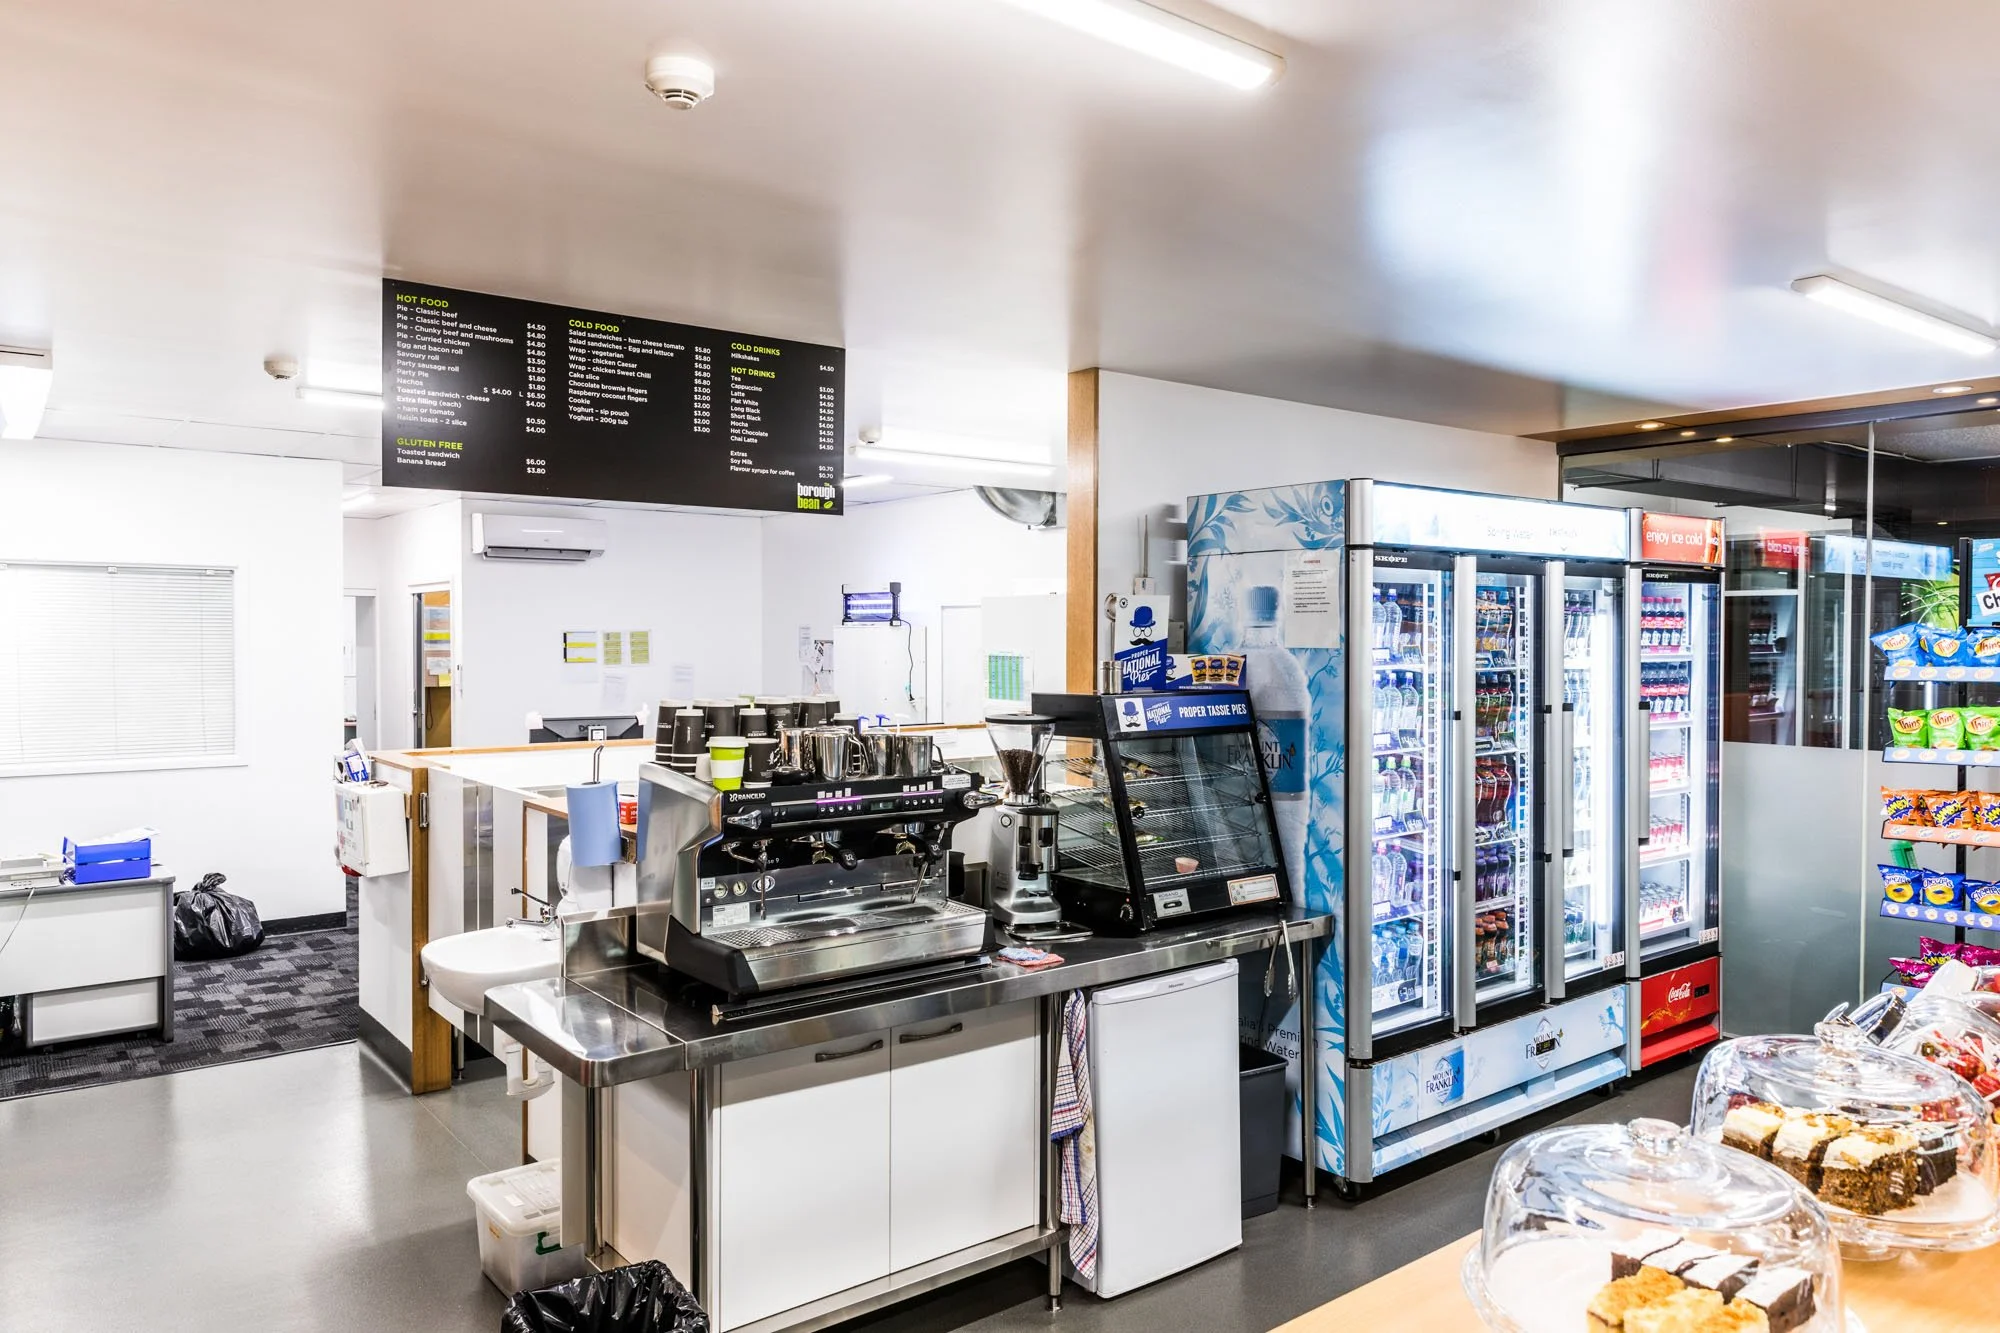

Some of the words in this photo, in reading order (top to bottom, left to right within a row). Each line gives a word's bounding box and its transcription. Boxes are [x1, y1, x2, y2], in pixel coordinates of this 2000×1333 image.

[396, 293, 418, 303] HOT
[420, 297, 449, 308] FOOD
[396, 304, 408, 312] Pie
[415, 307, 440, 316] Classic
[441, 310, 458, 318] beef
[526, 322, 546, 331] $4.50
[396, 313, 408, 321] Pie
[415, 316, 440, 325] Classic
[441, 319, 458, 327] beef
[473, 324, 497, 333] cheese
[526, 331, 546, 340] $4.80
[568, 319, 593, 329] COLD
[594, 323, 620, 333] FOOD
[396, 322, 408, 330] Pie
[414, 325, 442, 335] Chunky
[442, 328, 459, 336] beef
[474, 334, 514, 344] mushrooms
[526, 340, 546, 348] $4.80
[568, 329, 587, 337] Salad
[587, 332, 623, 342] sandwiches
[642, 339, 663, 347] cheese
[663, 342, 685, 350] tomato
[694, 346, 711, 354] $5.80
[396, 331, 409, 339] Pie
[415, 334, 442, 343] Curried
[443, 338, 471, 347] chicken
[526, 348, 546, 357] $4.80
[568, 337, 587, 345] Salad
[587, 341, 623, 350] sandwiches
[628, 345, 641, 353] Egg
[653, 348, 674, 357] lettuce
[695, 354, 711, 362] $5.80
[731, 342, 752, 352] COLD
[753, 345, 781, 356] DRINKS
[396, 340, 412, 349] Egg
[428, 344, 450, 353] bacon
[527, 357, 546, 365] $3.50
[568, 345, 587, 354] Wrap
[591, 350, 624, 358] vegetarian
[694, 362, 711, 370] $6.50
[730, 352, 760, 361] Milkshakes
[396, 350, 426, 360] Savoury
[527, 365, 546, 374] $3.50
[568, 354, 587, 363] Wrap
[592, 357, 616, 366] chicken
[616, 360, 638, 368] Caesar
[694, 370, 711, 378] $6.80
[396, 359, 416, 368] Party
[417, 362, 447, 371] sausage
[528, 374, 546, 382] $1.80
[568, 362, 587, 371] Wrap
[592, 366, 616, 374] chicken
[616, 368, 636, 377] Sweet
[636, 371, 652, 379] Chilli
[694, 378, 711, 386] $6.80
[731, 366, 747, 374] HOT
[748, 368, 776, 378] DRINKS
[396, 368, 416, 377] Party
[417, 370, 429, 378] Pie
[528, 383, 546, 391] $1.80
[568, 371, 585, 379] Cake
[585, 373, 600, 381] slice
[693, 386, 711, 394] $3.00
[568, 379, 601, 389] Chocolate
[601, 383, 626, 392] brownie
[626, 386, 648, 394] fingers
[730, 382, 763, 392] Cappuccino
[396, 377, 424, 386] Nachos
[491, 387, 512, 396] $4.00
[526, 391, 546, 400] $6.50
[568, 388, 601, 398] Raspberry
[601, 392, 626, 400] coconut
[627, 394, 648, 403] fingers
[396, 386, 426, 395] Toasted
[427, 391, 460, 399] sandwich
[466, 394, 490, 402] cheese
[526, 400, 546, 408] $4.00
[568, 396, 591, 405] Cookie
[568, 405, 594, 413] Yoghurt
[599, 408, 610, 416] sip
[568, 413, 594, 422] Yoghurt
[600, 416, 617, 425] 200g
[397, 438, 436, 448] GLUTEN
[438, 441, 463, 450] FREE
[396, 447, 426, 456] Toasted
[427, 451, 460, 459] sandwich
[526, 458, 546, 466] $6.00
[396, 456, 424, 465] Banana
[425, 459, 446, 467] Bread
[797, 482, 836, 500] borough
[797, 496, 820, 510] bean
[1646, 530, 1670, 546] enjoy
[1671, 532, 1684, 544] ice
[1685, 532, 1703, 546] cold
[1131, 649, 1149, 660] PROPER
[1178, 705, 1207, 718] PROPER
[1207, 705, 1231, 717] TASSIE
[1231, 703, 1247, 715] PIES
[1931, 711, 1957, 725] Thins
[1897, 717, 1921, 729] Thins
[737, 792, 766, 801] RANCILIO
[1533, 1031, 1554, 1044] MOUNT
[1264, 1041, 1300, 1059] Water
[1432, 1069, 1452, 1081] MOUNT
[1425, 1075, 1459, 1094] FRANKLIN
